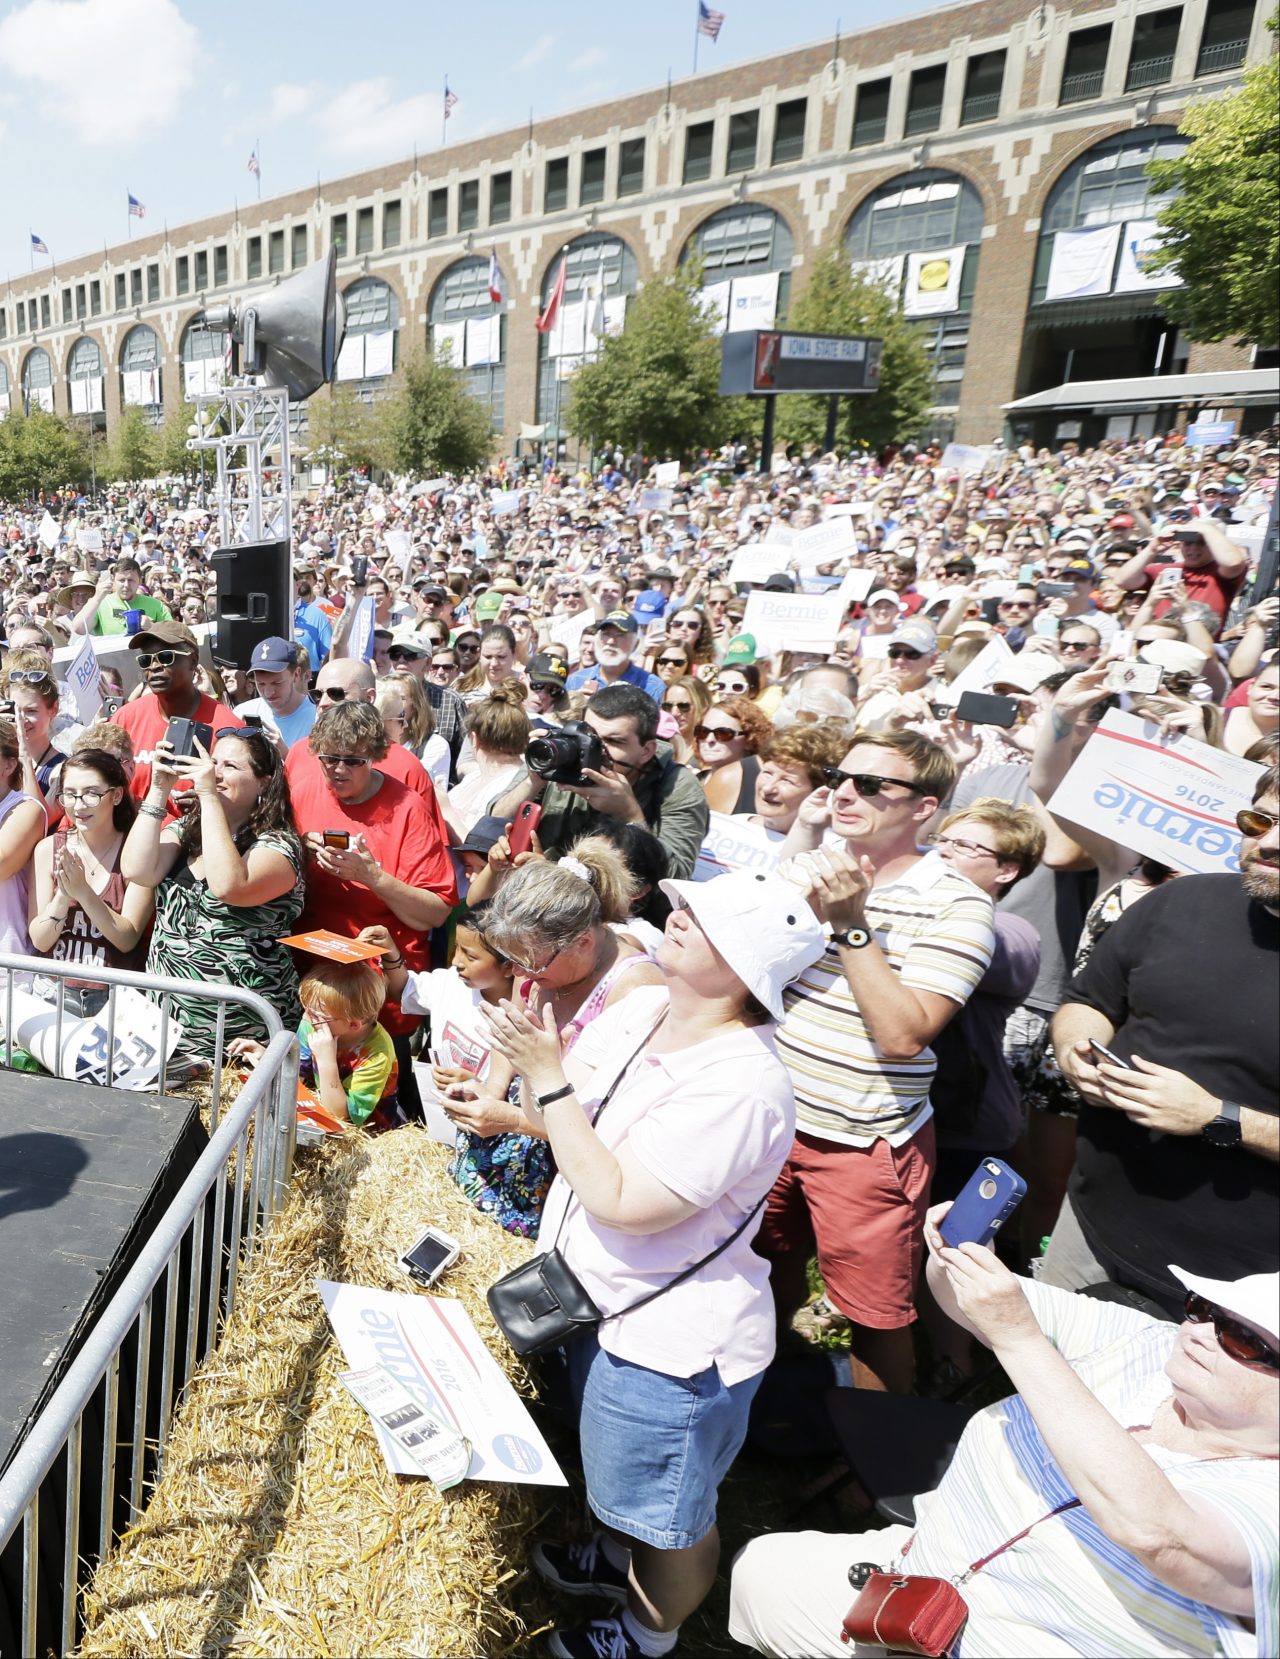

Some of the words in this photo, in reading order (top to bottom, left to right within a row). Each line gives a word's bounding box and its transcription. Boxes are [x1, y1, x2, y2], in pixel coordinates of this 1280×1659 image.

[815, 340, 839, 357] STATE
[760, 601, 829, 620] Bernie
[76, 651, 94, 688] Ber
[1175, 785, 1225, 812] 2016
[431, 1358, 463, 1392] 2016
